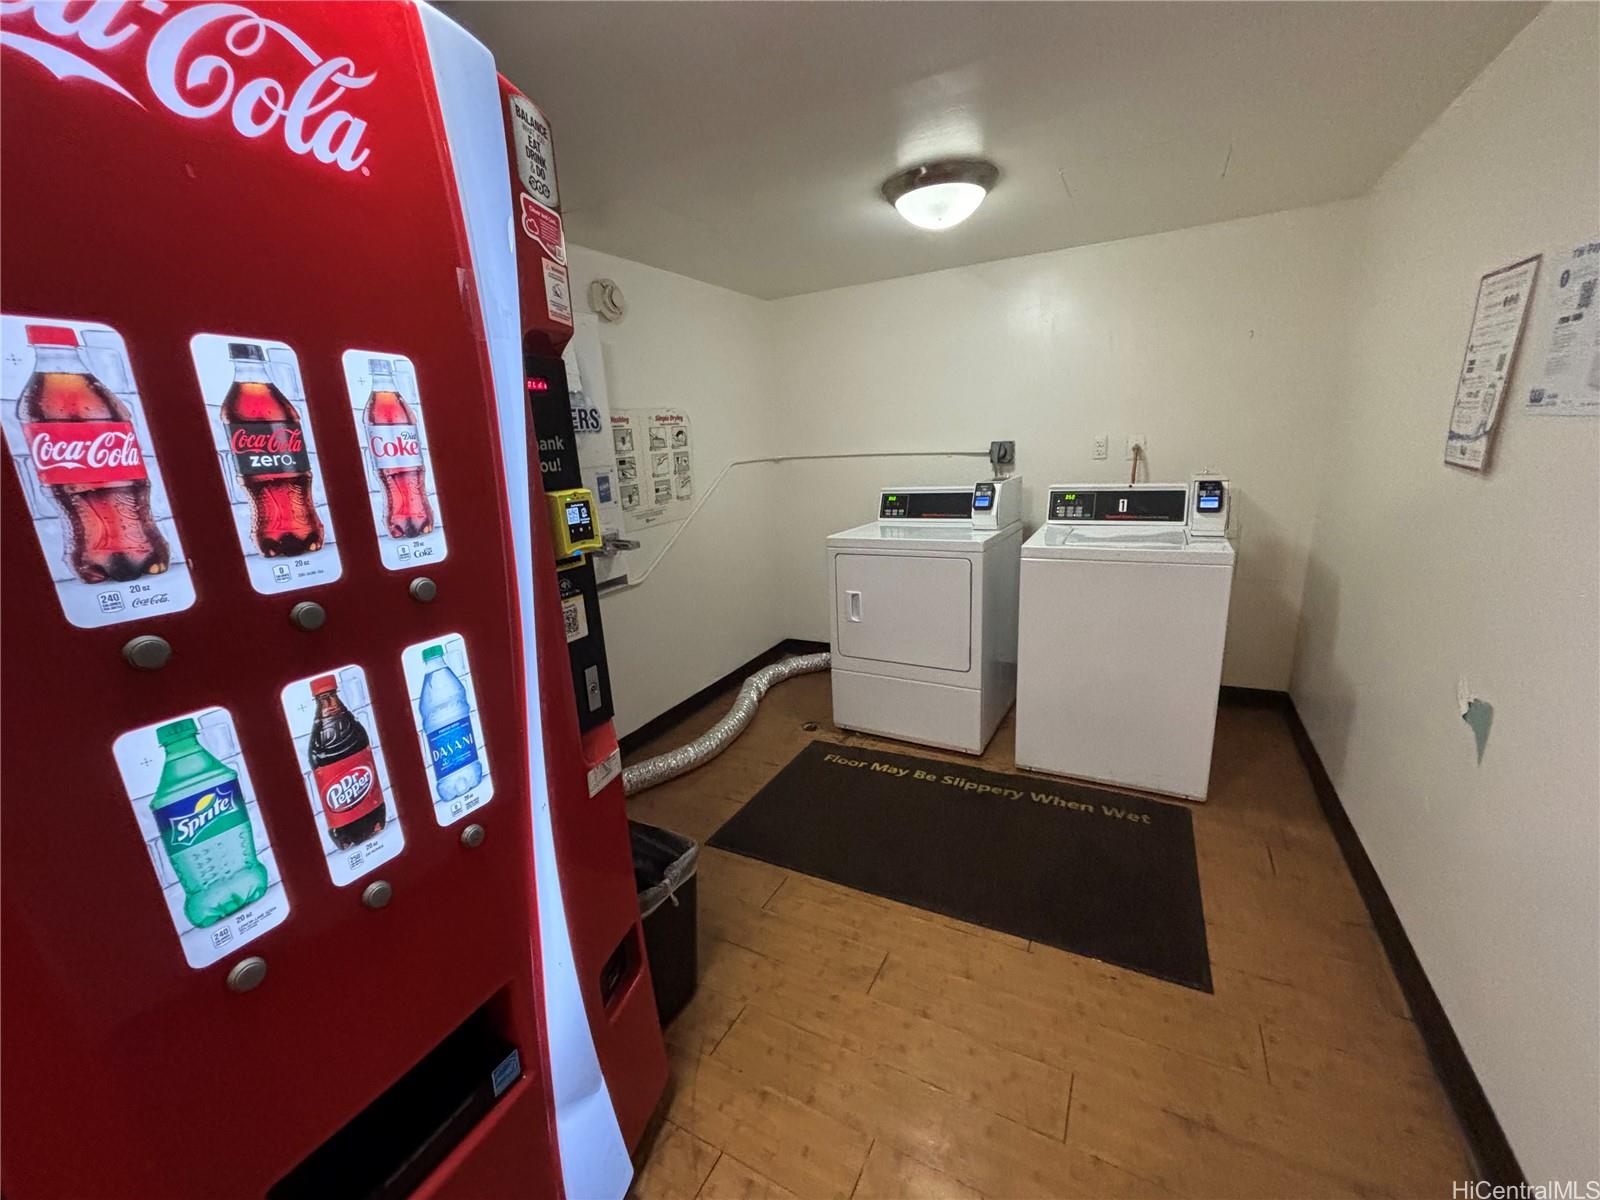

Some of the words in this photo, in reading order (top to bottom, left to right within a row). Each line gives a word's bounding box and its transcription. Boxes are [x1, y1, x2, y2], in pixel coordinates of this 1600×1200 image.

[514, 103, 548, 140] BALANCE
[527, 134, 541, 153] EAT
[525, 144, 547, 170] DRINK
[536, 164, 546, 180] DO
[231, 428, 302, 454] Coca-Cola
[401, 431, 417, 441] Diet
[539, 435, 565, 450] ank
[32, 432, 140, 469] Coca-Cola
[370, 436, 420, 458] Coke
[294, 559, 304, 568] 20
[100, 593, 120, 604] 240
[129, 584, 141, 594] 20
[433, 732, 473, 762] DASANI
[329, 771, 370, 810] Pepper
[340, 772, 359, 791] Dr
[823, 753, 868, 769] Floor
[871, 760, 908, 778] May
[913, 769, 937, 782] Be
[941, 775, 1024, 801] Slippery
[1031, 791, 1095, 814] When
[1102, 806, 1153, 825] Wet
[177, 797, 230, 842] Sprite
[236, 914, 246, 924] 20
[213, 928, 229, 940] 240
